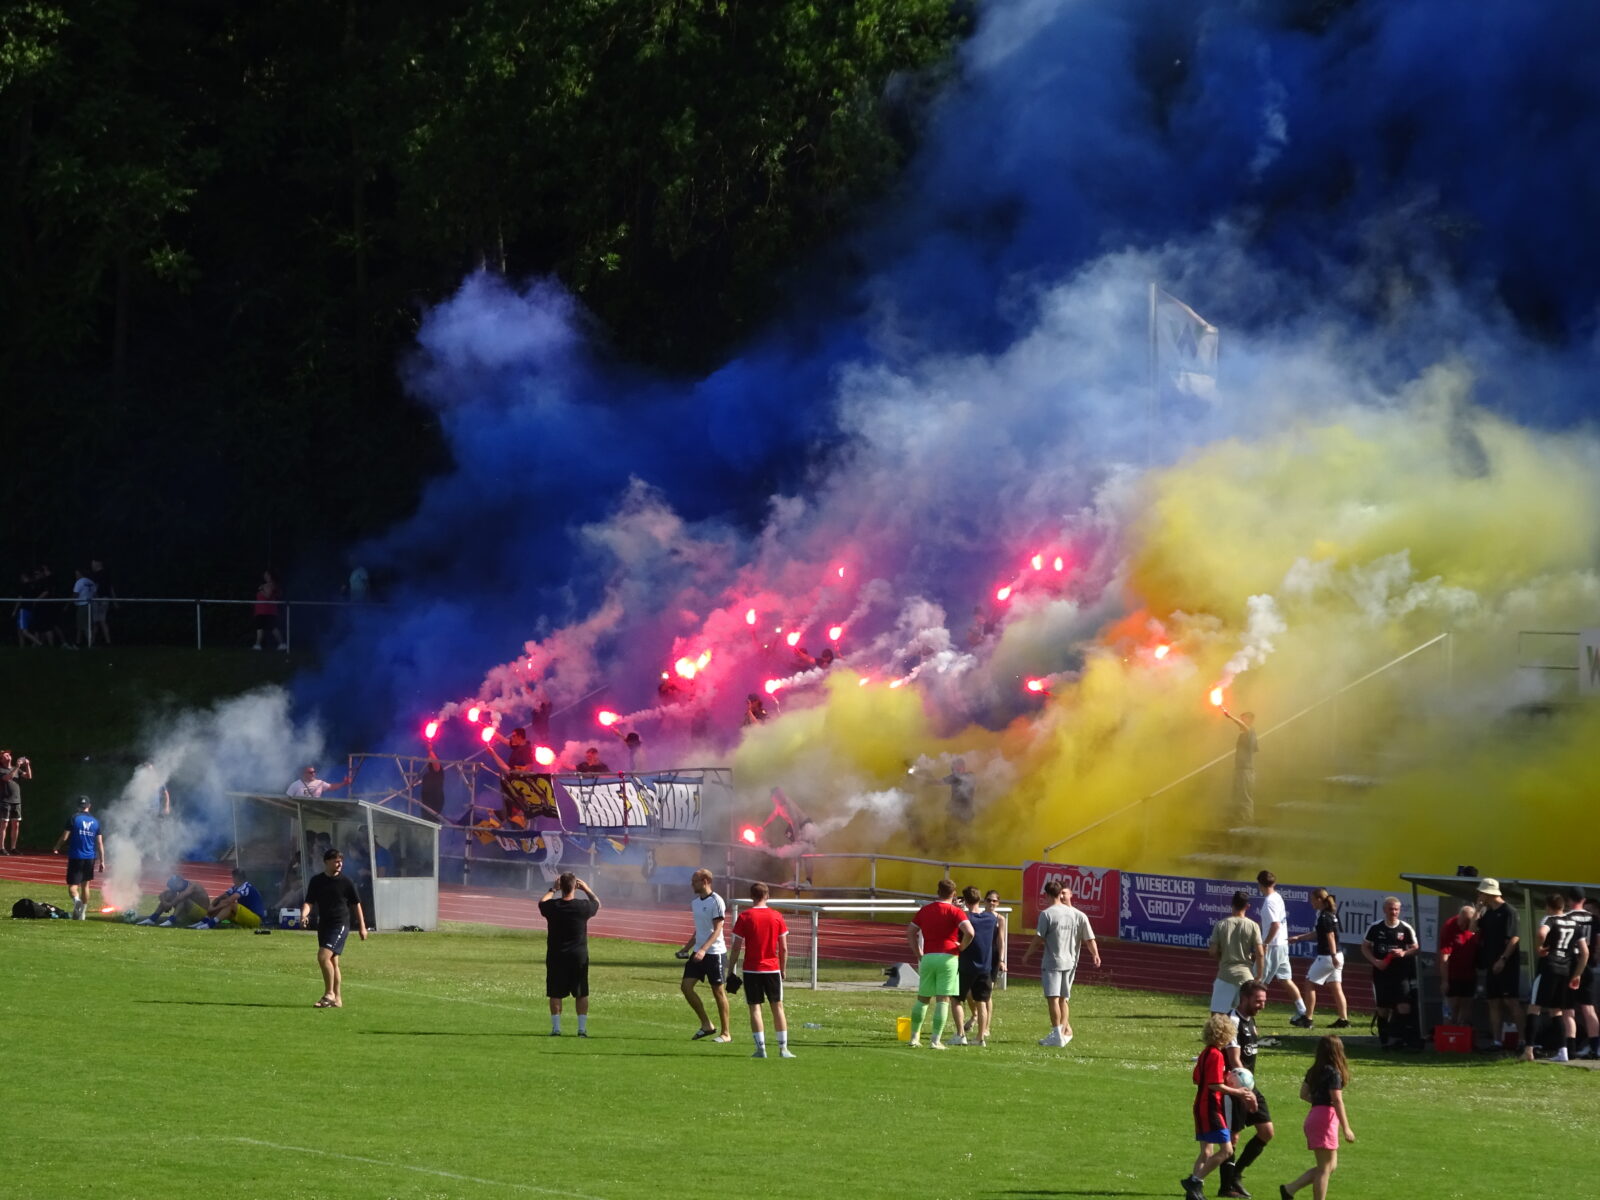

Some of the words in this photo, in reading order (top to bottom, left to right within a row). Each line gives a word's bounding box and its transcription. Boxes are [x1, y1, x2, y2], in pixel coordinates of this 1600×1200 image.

[1135, 876, 1196, 895] WIESECKER
[1147, 899, 1185, 917] GROUP
[1557, 928, 1575, 950] 17
